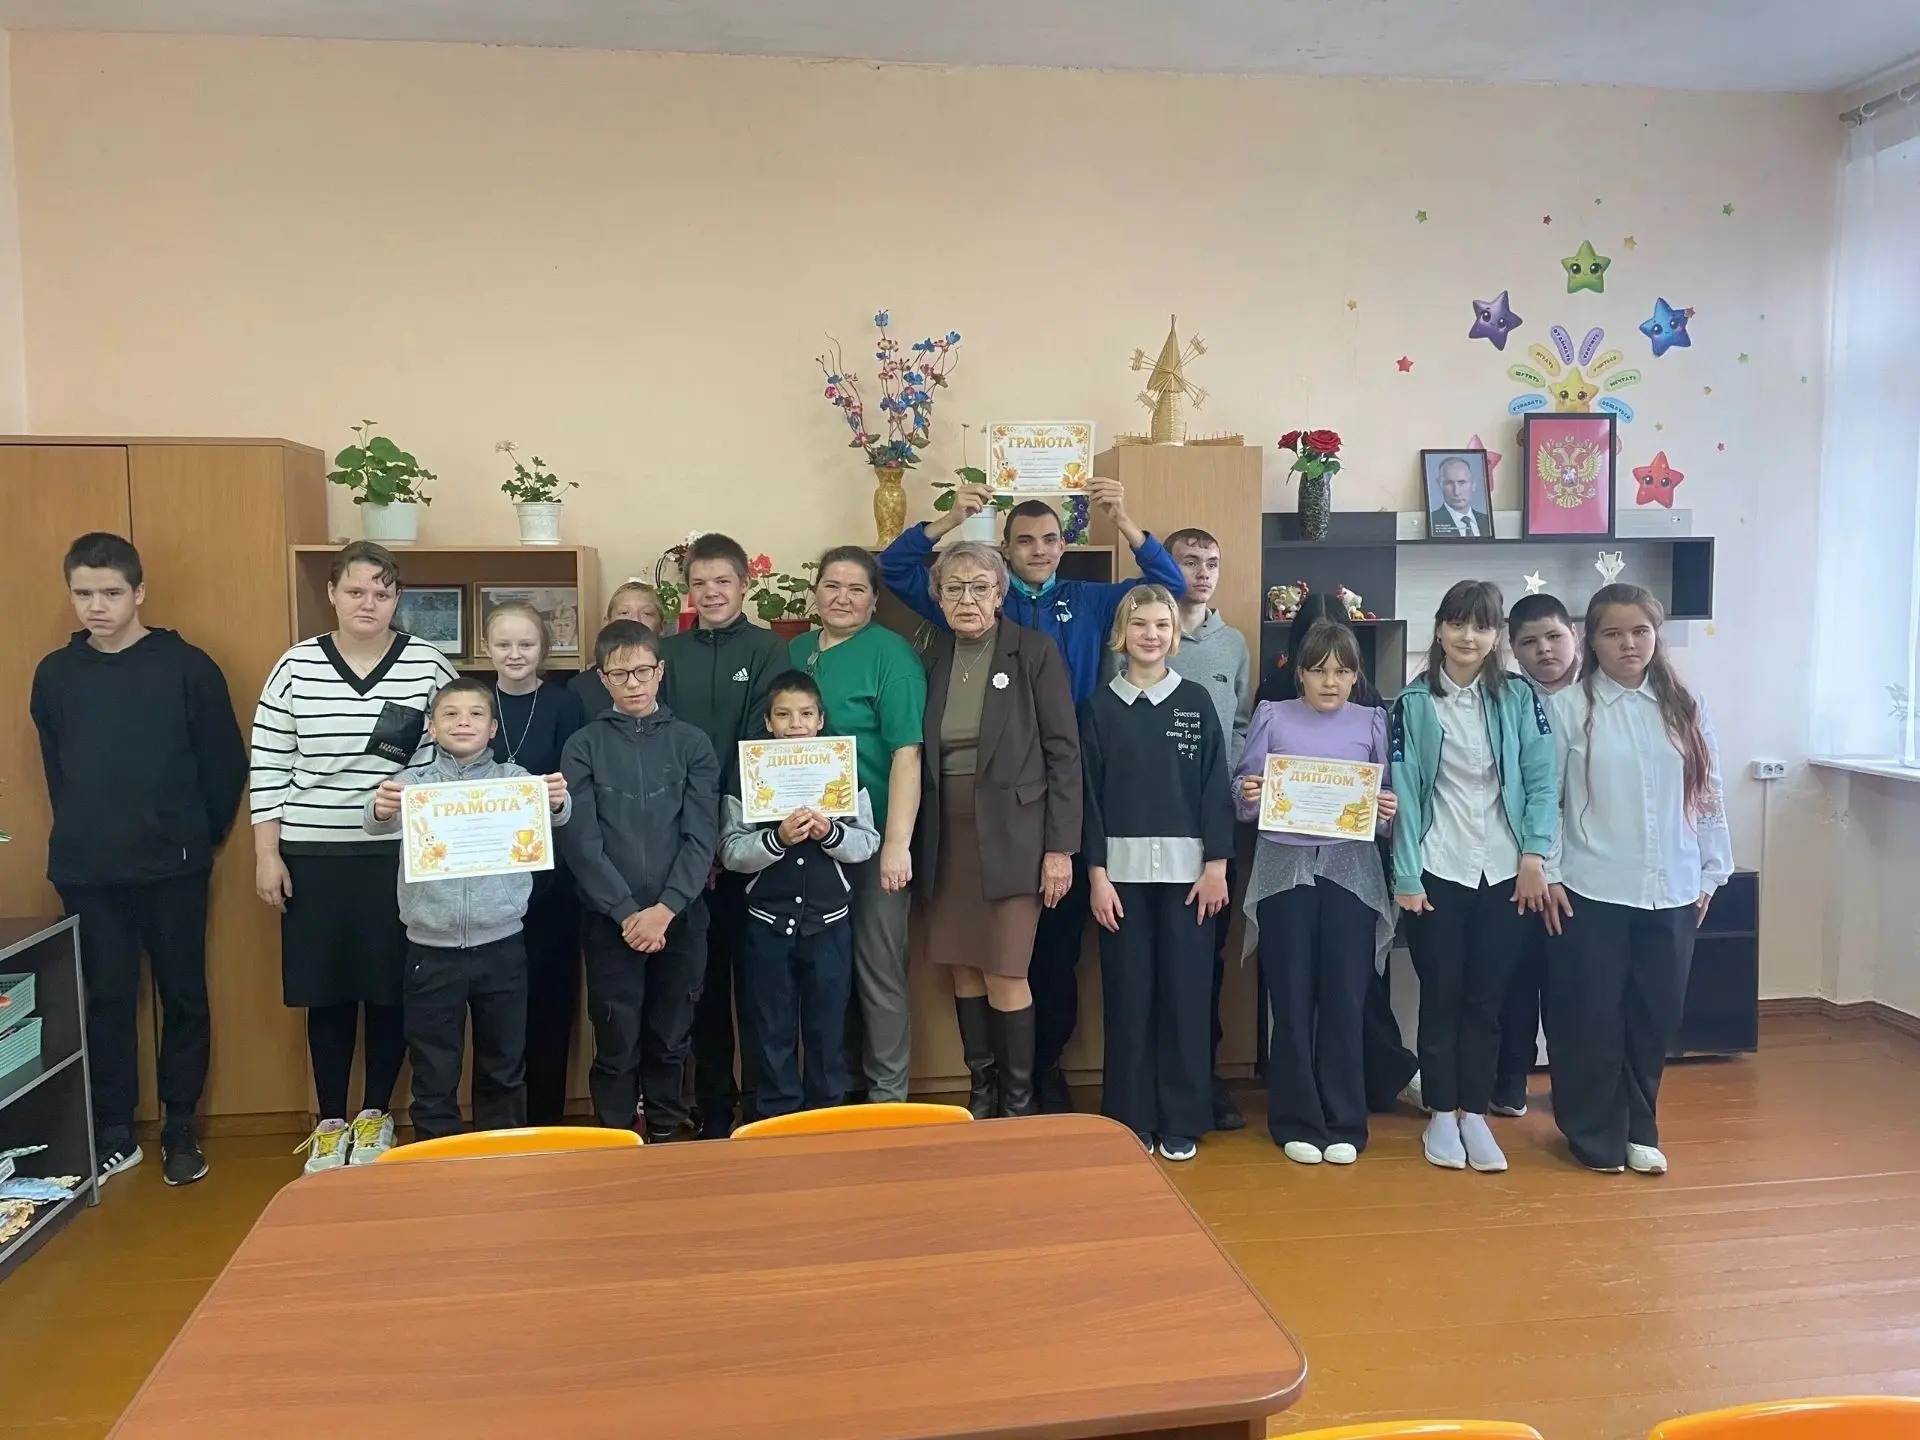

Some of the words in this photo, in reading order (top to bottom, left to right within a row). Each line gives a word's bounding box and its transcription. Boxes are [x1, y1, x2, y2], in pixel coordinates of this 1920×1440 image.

[1008, 436, 1074, 449] ГРАМОТА
[1173, 708, 1201, 718] Success
[1174, 719, 1189, 728] does
[1190, 721, 1201, 729] not
[1166, 730, 1183, 738] come
[1193, 734, 1202, 742] yo
[1178, 742, 1189, 751] you
[766, 753, 831, 768] ДИПЛОМ
[1289, 770, 1355, 787] ДИПЛОМ
[431, 797, 522, 818] ГРАМОТА
